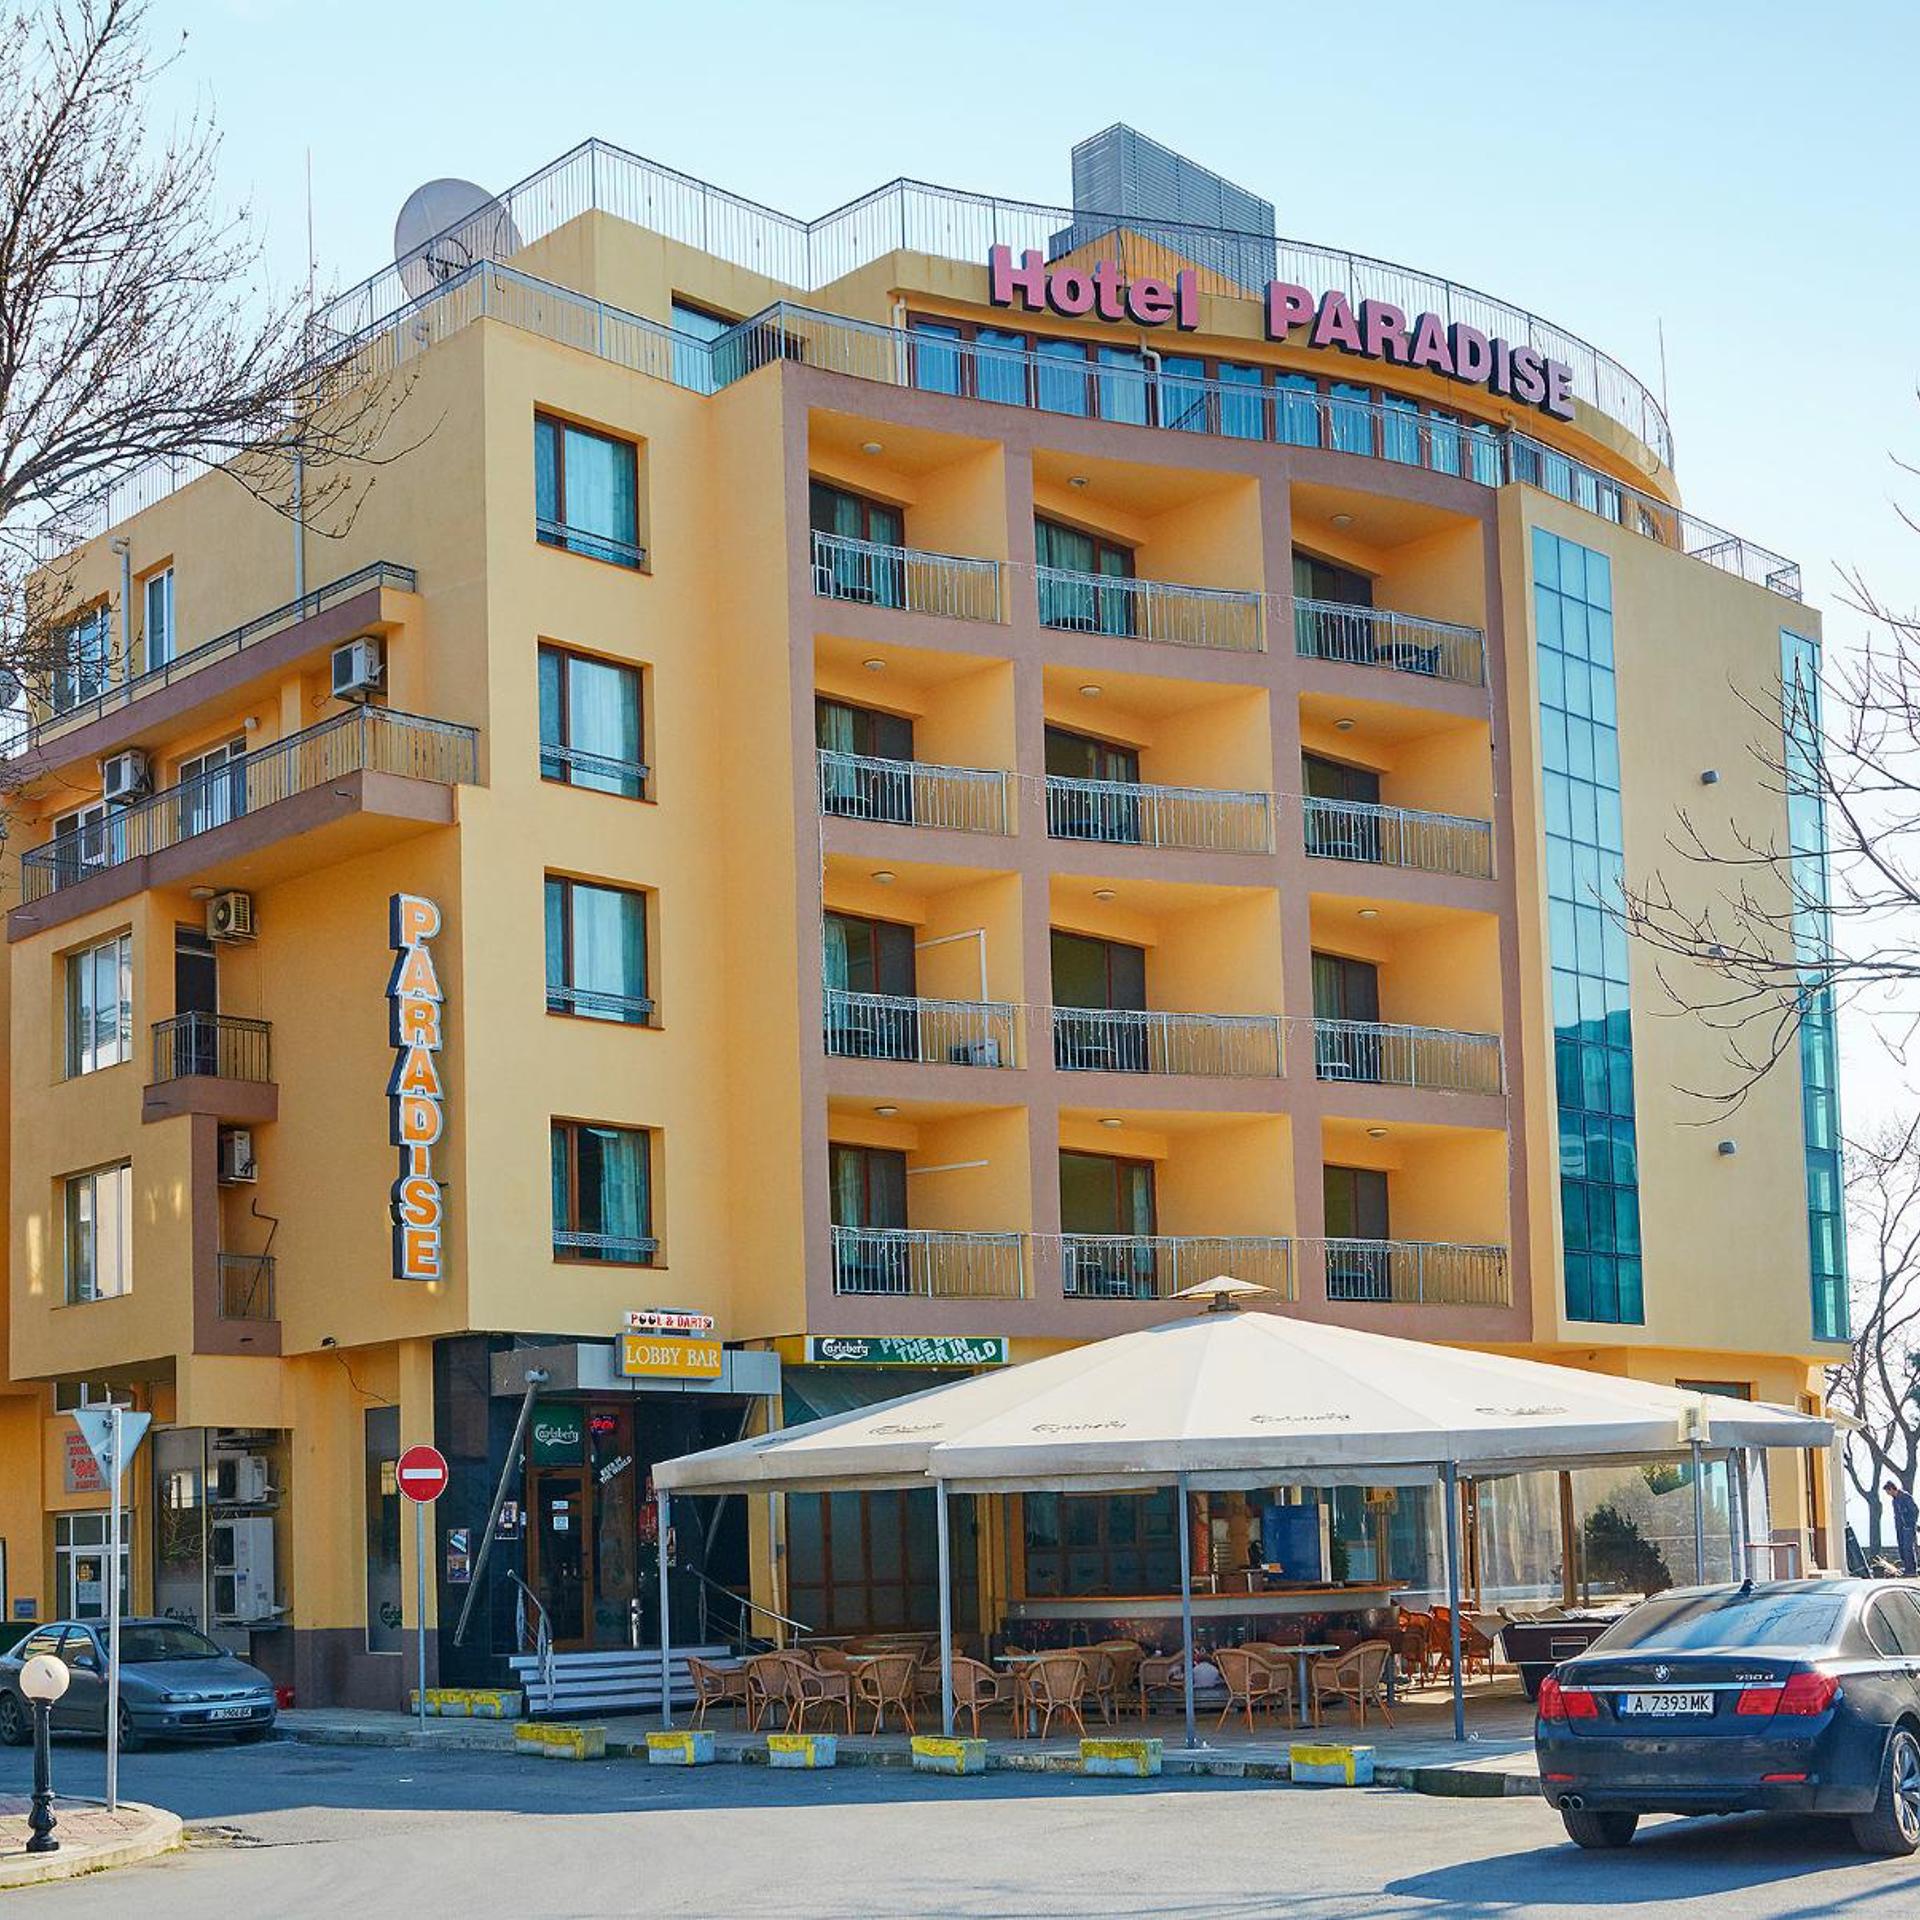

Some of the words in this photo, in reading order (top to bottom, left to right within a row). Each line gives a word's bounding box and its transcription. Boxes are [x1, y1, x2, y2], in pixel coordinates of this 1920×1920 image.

[989, 244, 1199, 332] Hotel
[1265, 280, 1576, 421] PARADISE
[391, 894, 443, 1279] PARADISE
[626, 1345, 680, 1365] LOBBY
[687, 1349, 719, 1367] BAR
[822, 1338, 870, 1360] Carlsberg
[535, 1424, 578, 1446] Carlsberg
[1634, 1696, 1643, 1711] A
[1651, 1695, 1688, 1711] 7393
[1690, 1695, 1711, 1710] MK
